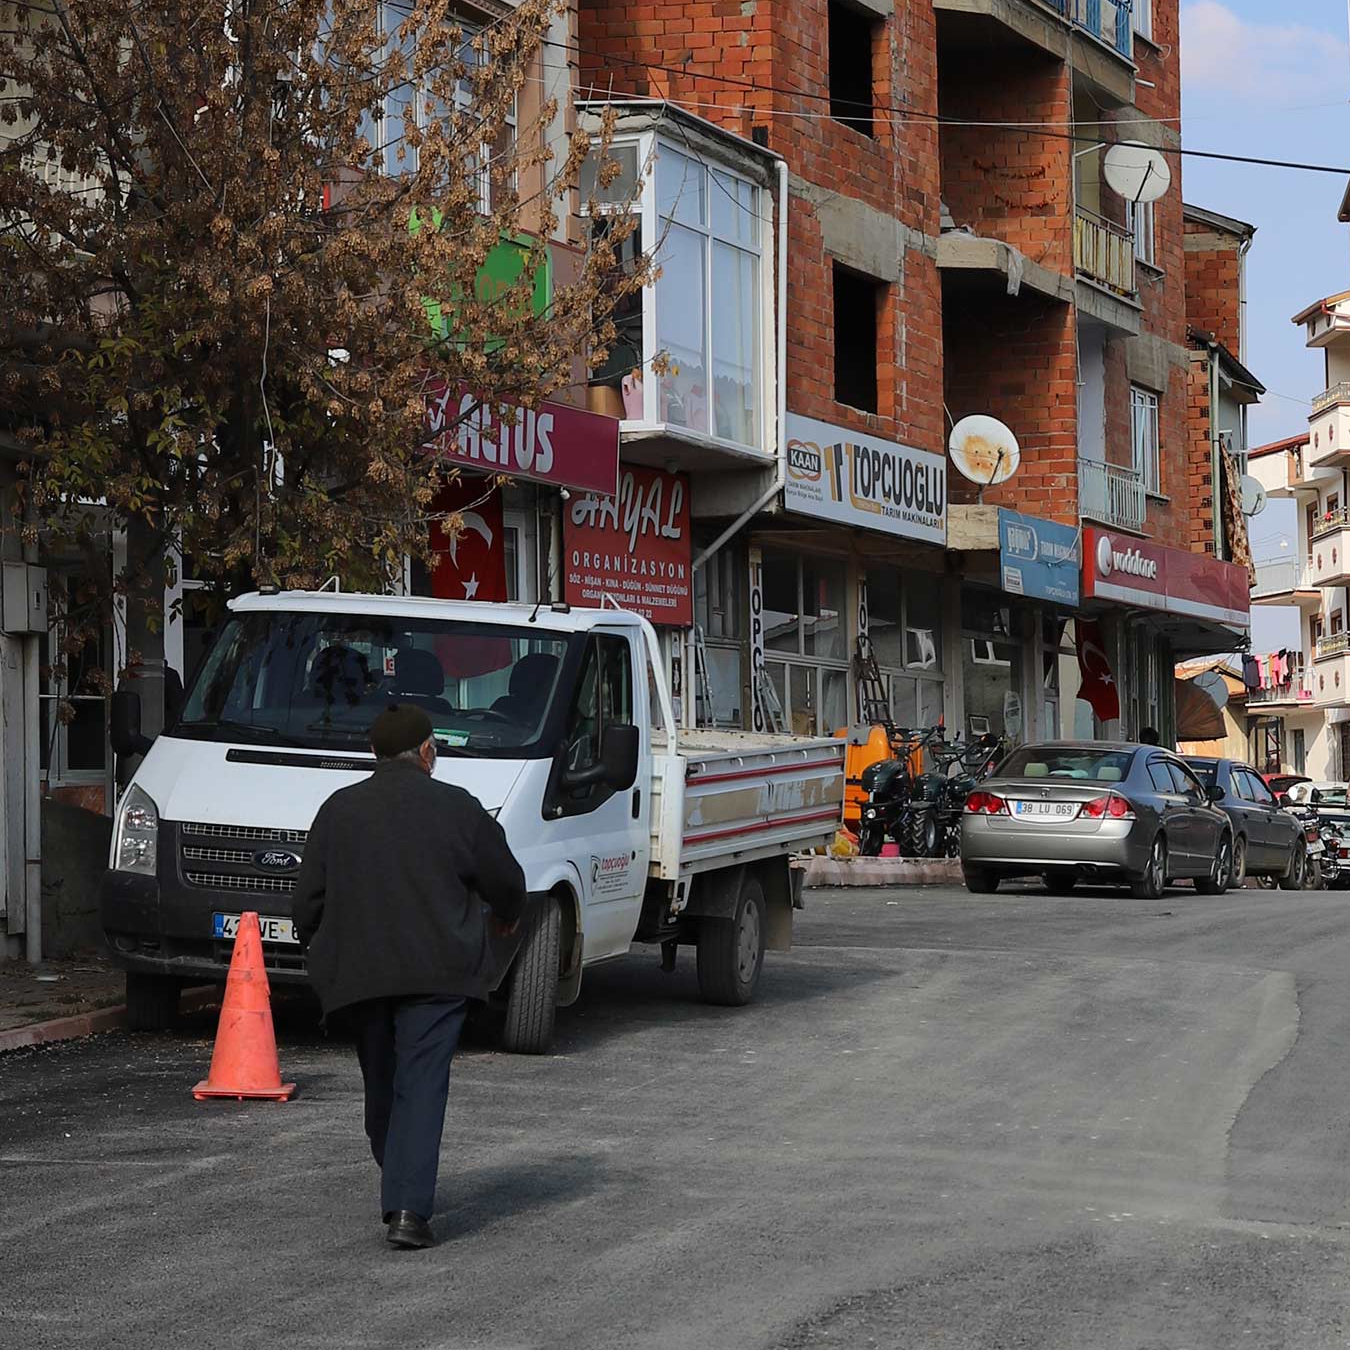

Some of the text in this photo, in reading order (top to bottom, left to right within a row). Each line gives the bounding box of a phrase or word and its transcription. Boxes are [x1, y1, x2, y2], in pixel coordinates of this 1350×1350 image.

[458, 393, 554, 474] ALTUS
[790, 449, 819, 471] KAAN
[881, 506, 901, 519] TARIM
[572, 550, 685, 579] ORGANİZASYON
[1112, 548, 1157, 579] vodafone
[262, 852, 291, 866] Ford
